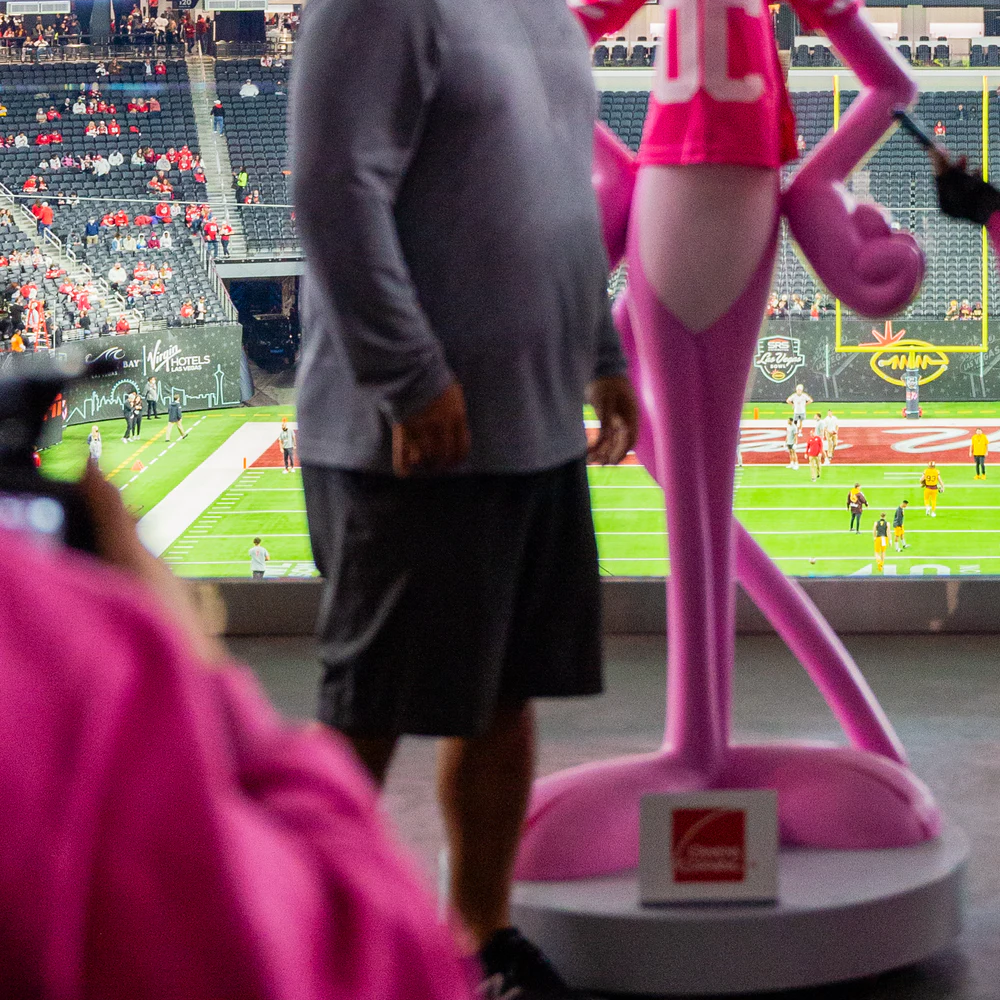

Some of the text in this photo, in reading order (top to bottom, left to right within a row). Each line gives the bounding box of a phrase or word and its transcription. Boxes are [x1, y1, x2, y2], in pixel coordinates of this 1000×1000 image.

[147, 339, 182, 373] Virgin
[170, 354, 211, 367] HOTELS
[756, 351, 776, 365] Las
[122, 359, 141, 369] BAY
[183, 364, 203, 372] VEGAS
